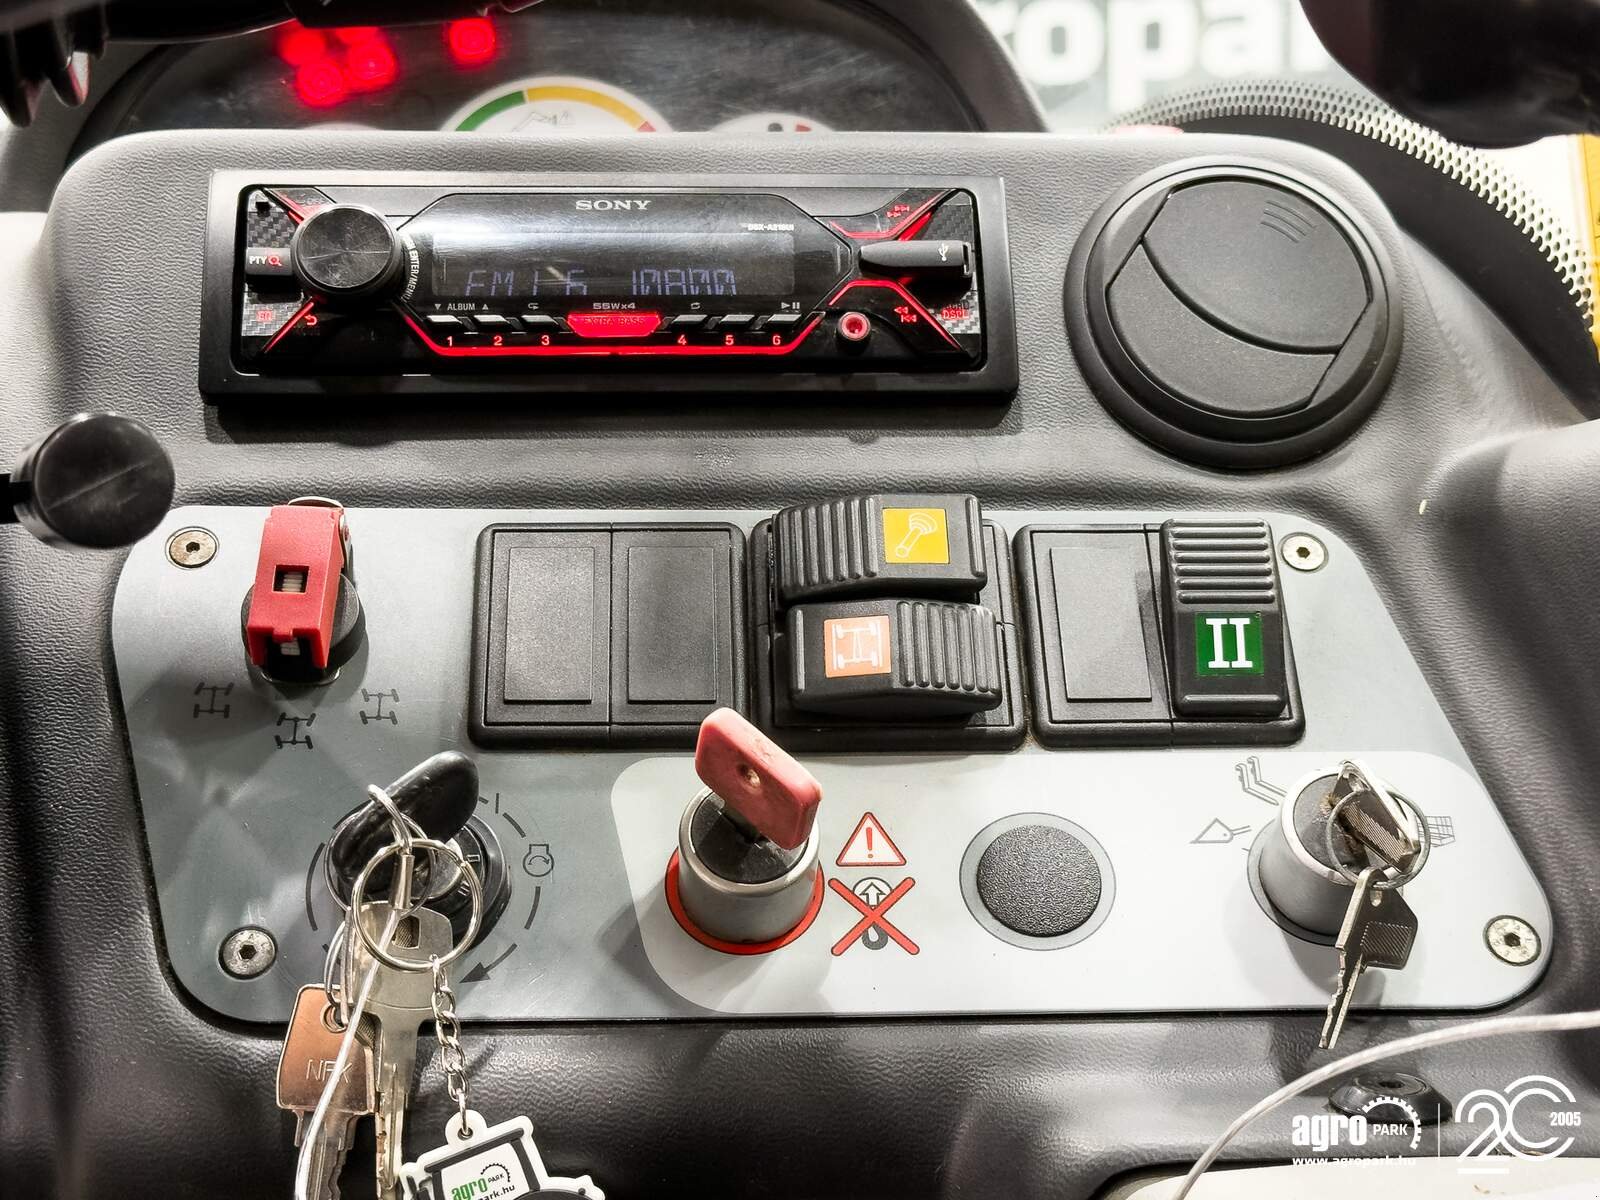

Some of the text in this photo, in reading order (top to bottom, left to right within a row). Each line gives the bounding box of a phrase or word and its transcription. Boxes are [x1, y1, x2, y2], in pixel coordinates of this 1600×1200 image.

[575, 200, 651, 210] SONY
[249, 255, 268, 265] PTY
[446, 303, 476, 311] ALBUM
[446, 335, 454, 346] 1
[493, 335, 503, 346] 2
[541, 334, 550, 346] 3
[677, 335, 687, 346] 4
[725, 335, 734, 346] 5
[772, 335, 781, 346] 6
[487, 1173, 505, 1183] PARK
